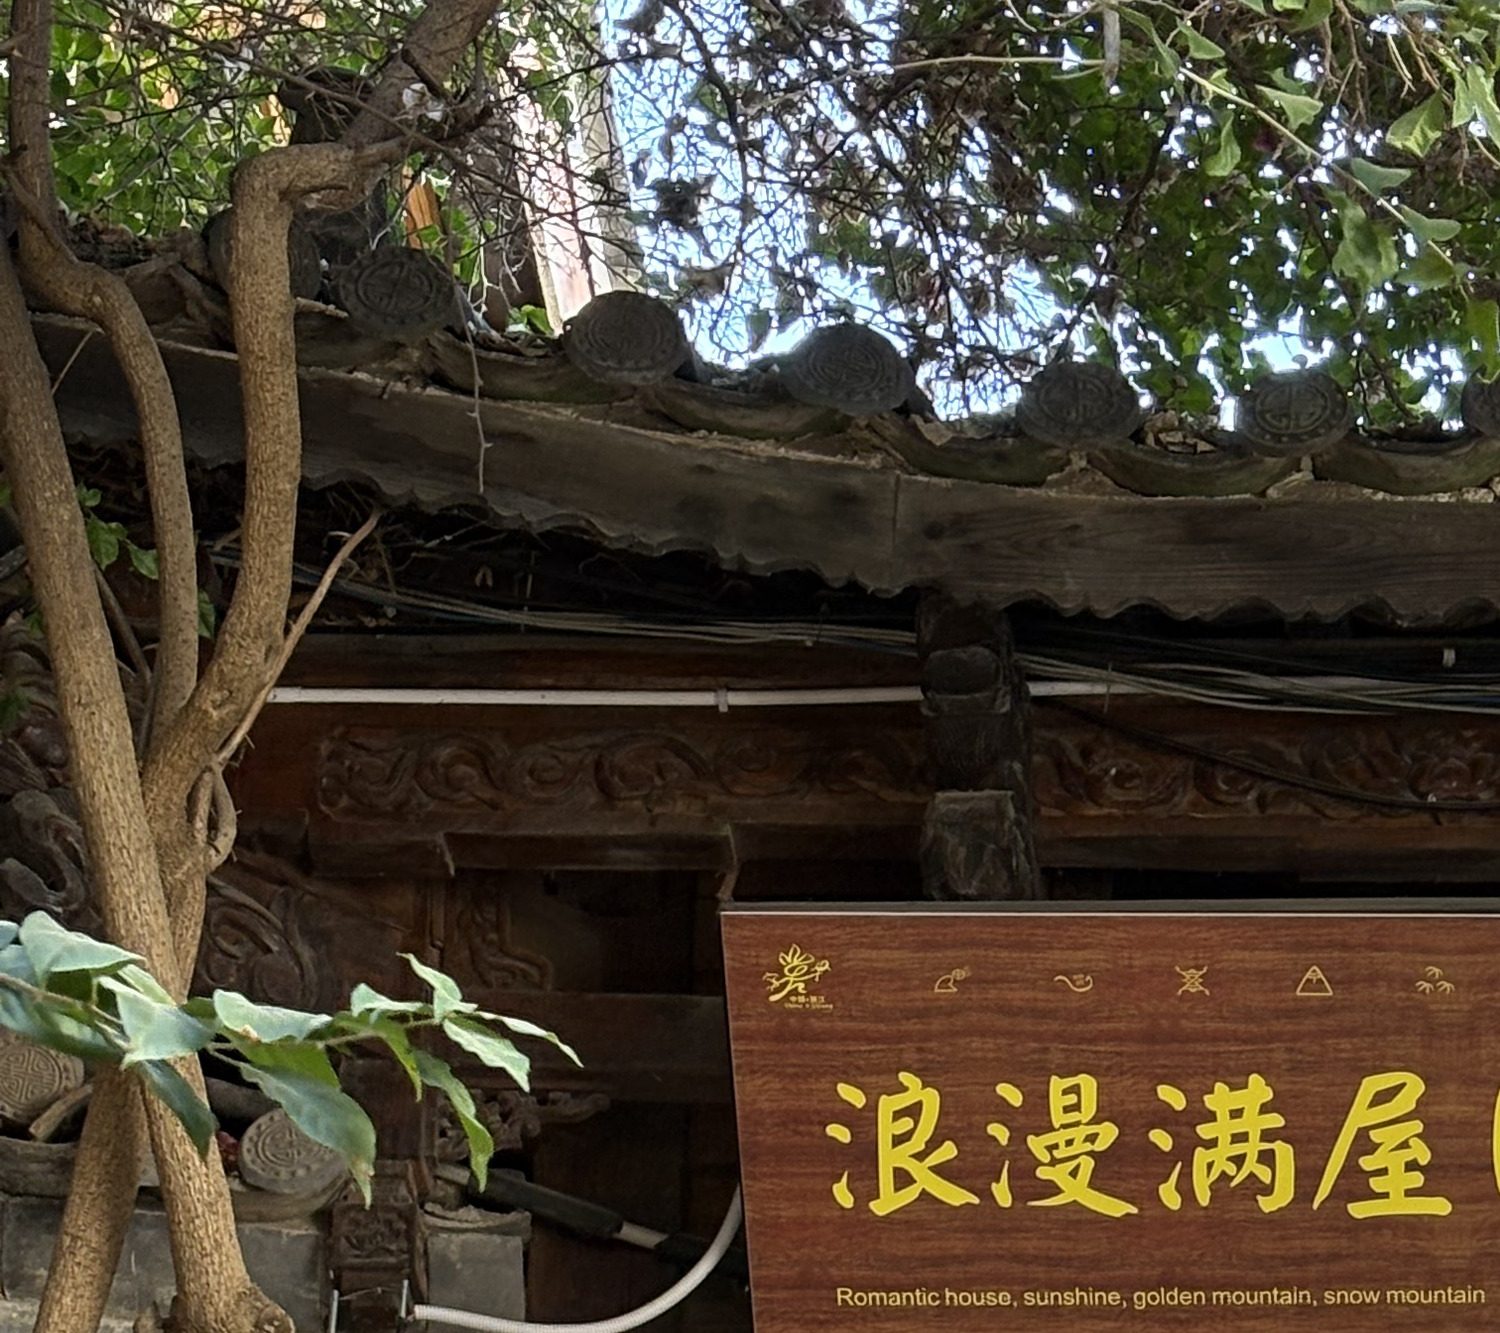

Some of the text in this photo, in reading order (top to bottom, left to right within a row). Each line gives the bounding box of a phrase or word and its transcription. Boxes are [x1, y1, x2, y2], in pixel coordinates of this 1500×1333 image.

[836, 1284, 1486, 1310] Romantic house, sunshine, golden mountain, snow mountain
